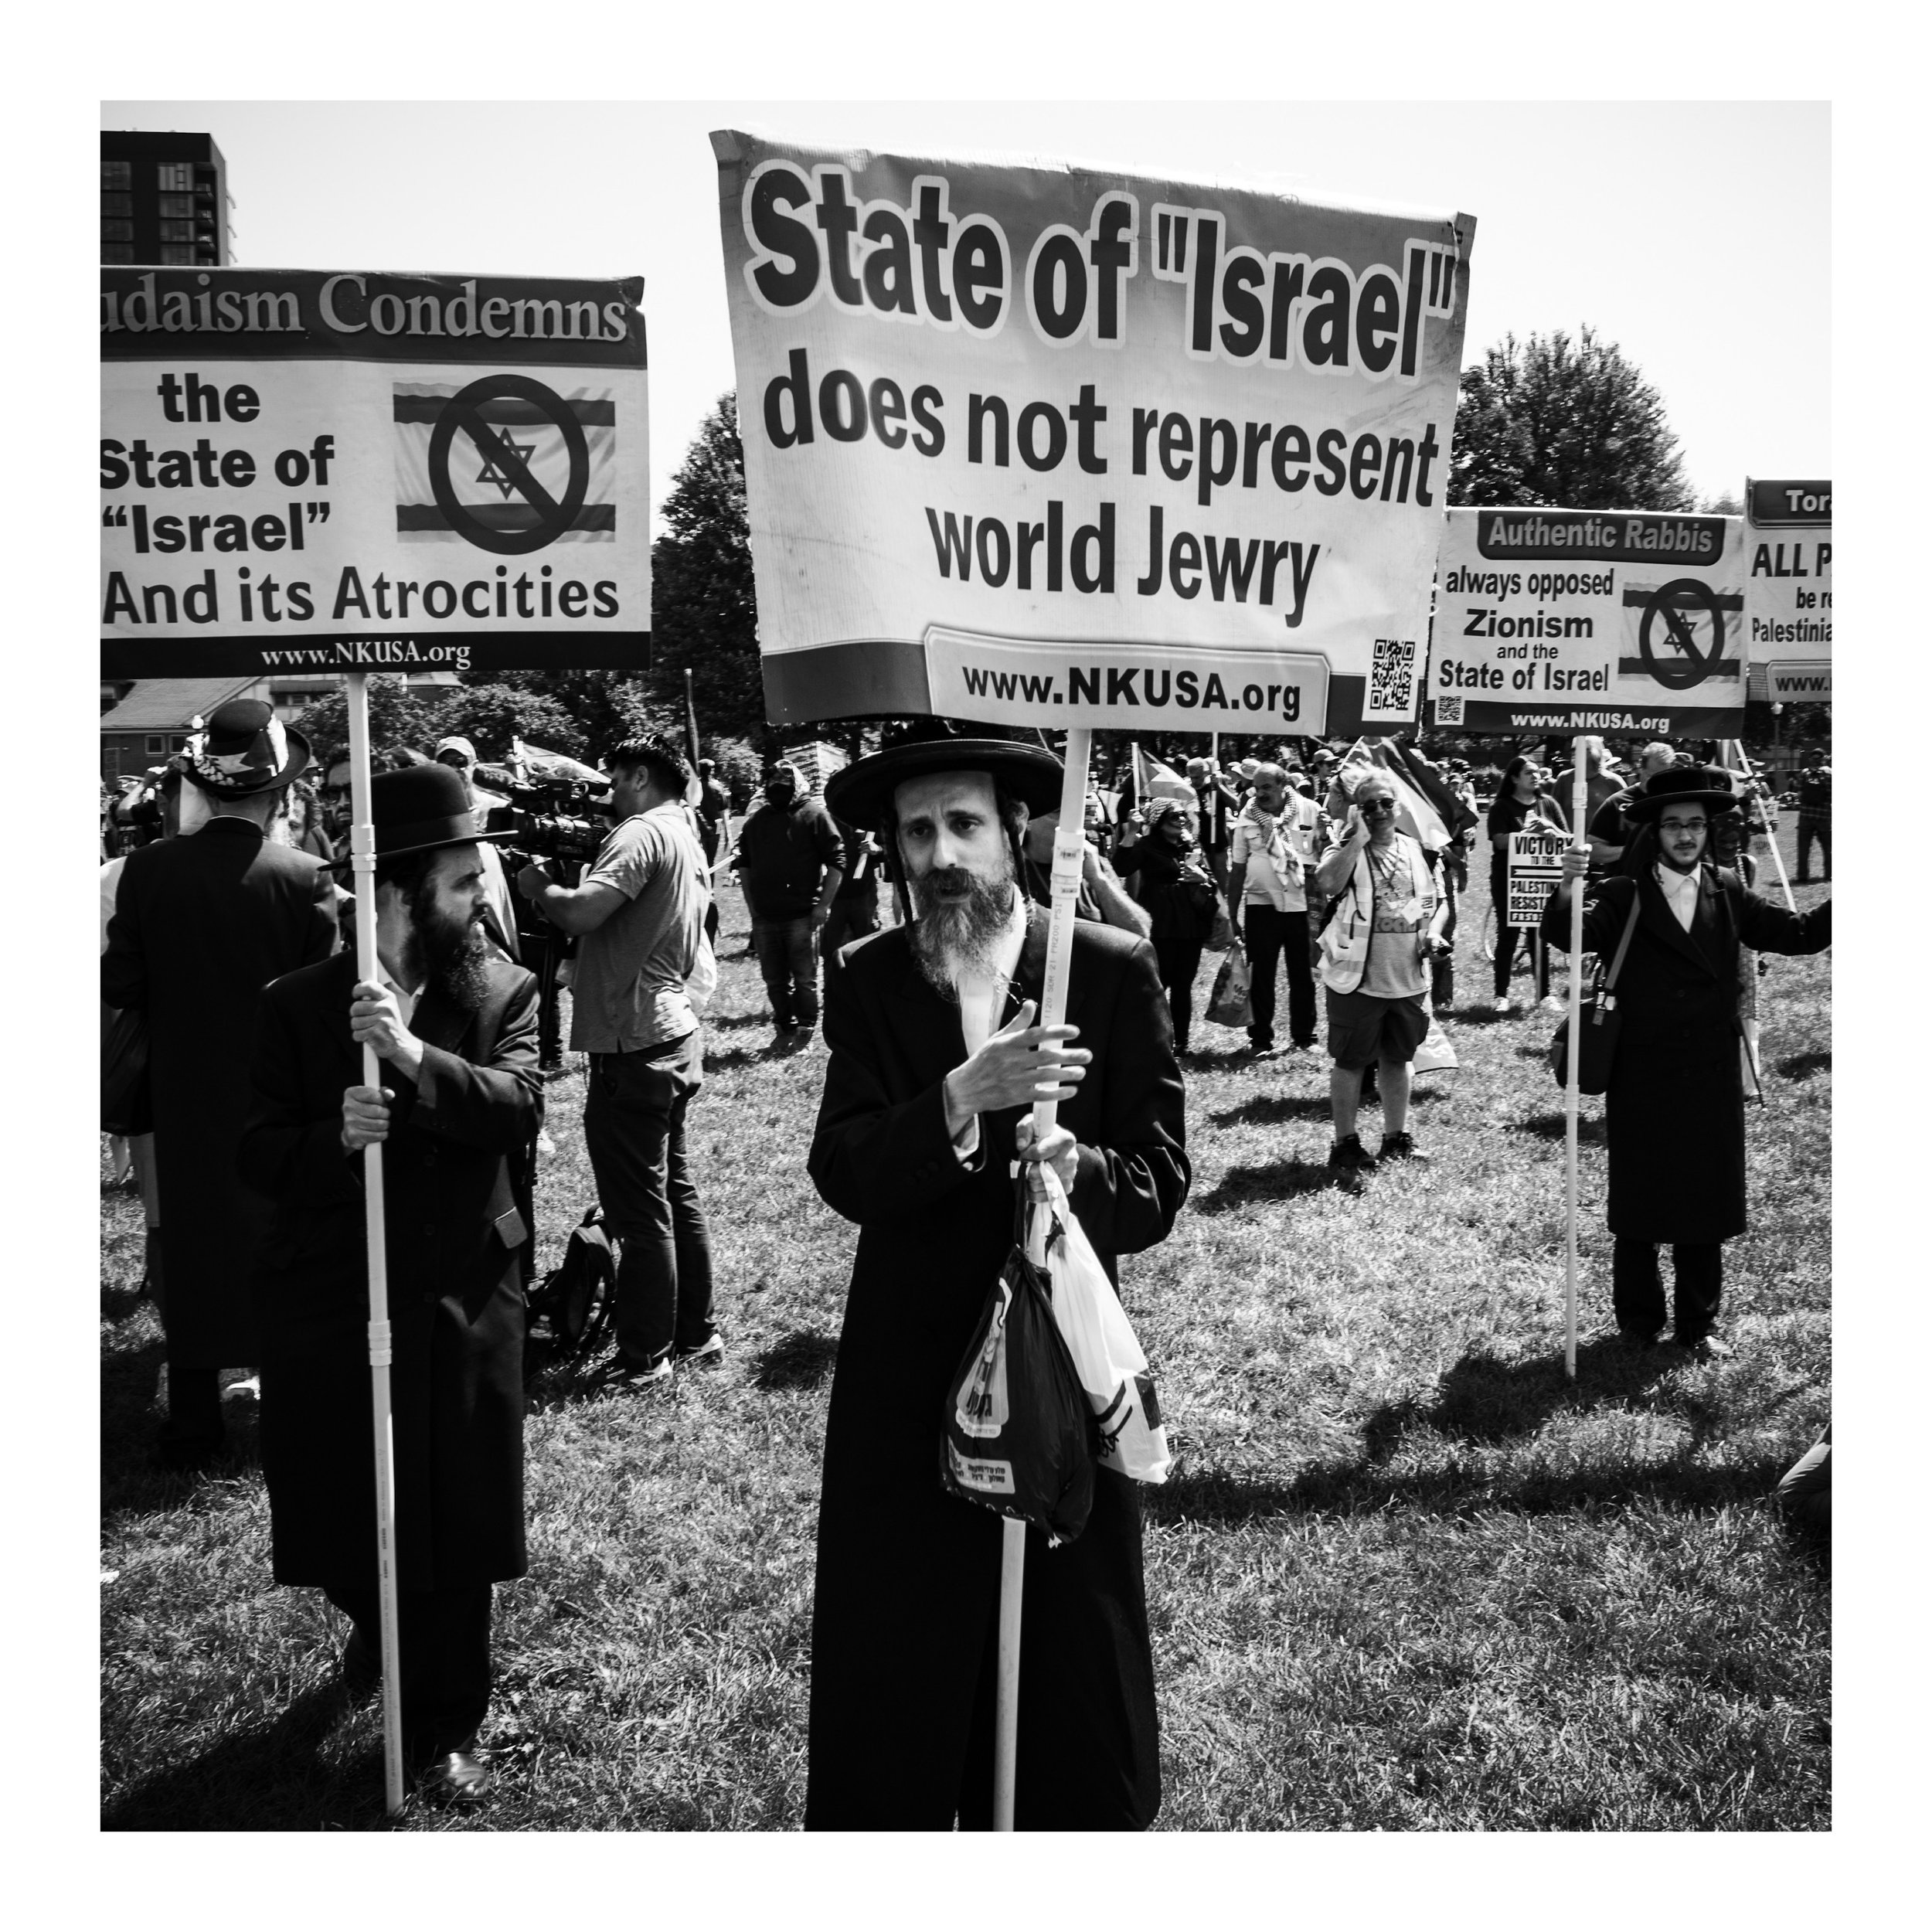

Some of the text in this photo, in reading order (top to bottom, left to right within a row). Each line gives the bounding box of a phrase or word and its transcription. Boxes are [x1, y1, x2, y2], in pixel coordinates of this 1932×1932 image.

[748, 167, 1456, 378] State of "Israel"
[318, 274, 628, 342] Condemns
[157, 372, 260, 423] the
[764, 348, 1438, 508] does not represent
[100, 434, 335, 490] State of
[1786, 489, 1832, 512] Tor
[1488, 516, 1713, 553] Authentic Rabbis
[925, 500, 1321, 628] world Jewry
[1750, 543, 1808, 577] ALL
[102, 565, 620, 624] And its Atrocities
[1446, 565, 1614, 602] always opposed
[1796, 586, 1816, 609] be
[1463, 608, 1594, 638] Zionism
[261, 641, 471, 670] www.NKUSA.org
[1497, 643, 1559, 659] and the
[1439, 658, 1610, 692] State of Israel
[1774, 676, 1832, 692] www.
[961, 666, 1301, 722] www.NKUSA.org
[1511, 712, 1671, 734] www.NKUSA.org
[1515, 836, 1573, 855] VICTORY
[1511, 896, 1546, 910] RESIST
